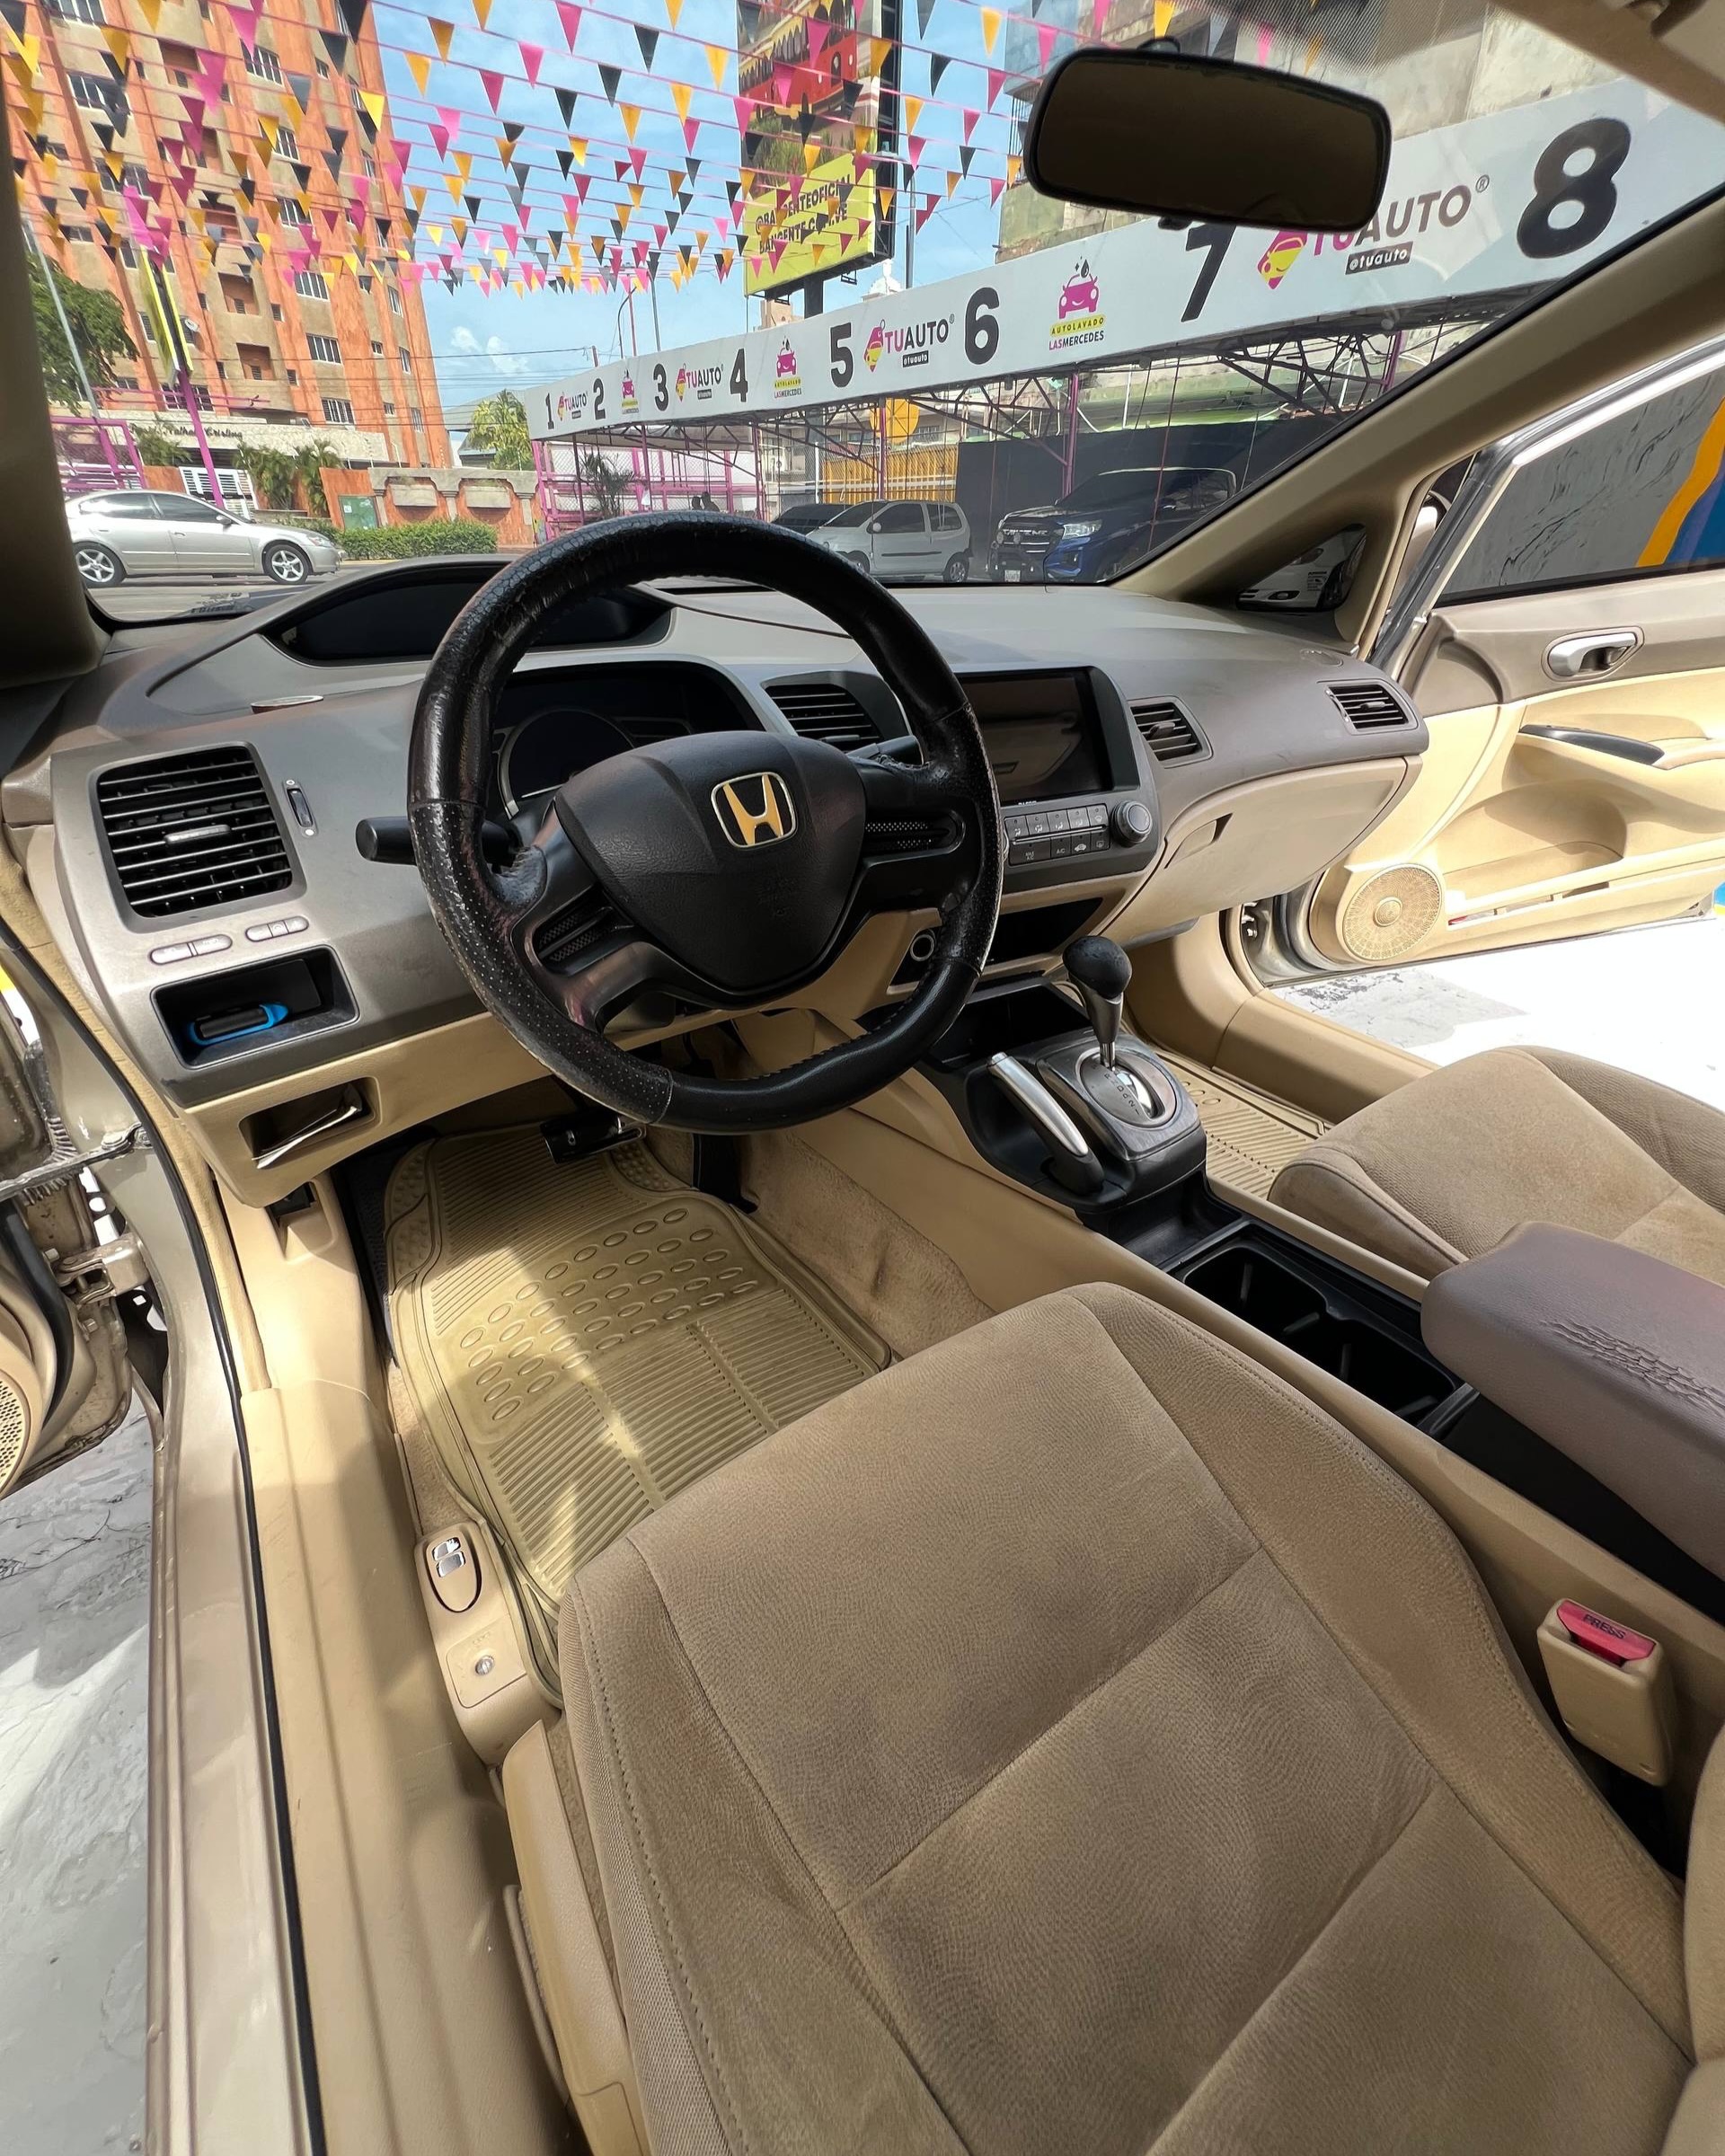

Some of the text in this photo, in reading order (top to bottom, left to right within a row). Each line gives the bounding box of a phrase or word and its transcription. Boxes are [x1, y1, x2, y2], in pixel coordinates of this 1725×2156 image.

[1517, 117, 1632, 259] 8
[1181, 224, 1236, 322] 7
[1349, 248, 1408, 270] @tuauto
[885, 320, 949, 354] TUAUTO
[964, 287, 1000, 365] 6
[1050, 317, 1105, 336] AUTOLAVADO
[730, 348, 749, 402] 4
[830, 322, 854, 388] 5
[593, 378, 606, 420] 2
[653, 363, 669, 411] 3
[686, 367, 721, 389] TUAUTO
[544, 393, 555, 429] 1
[1582, 1613, 1626, 1640] PRESS
